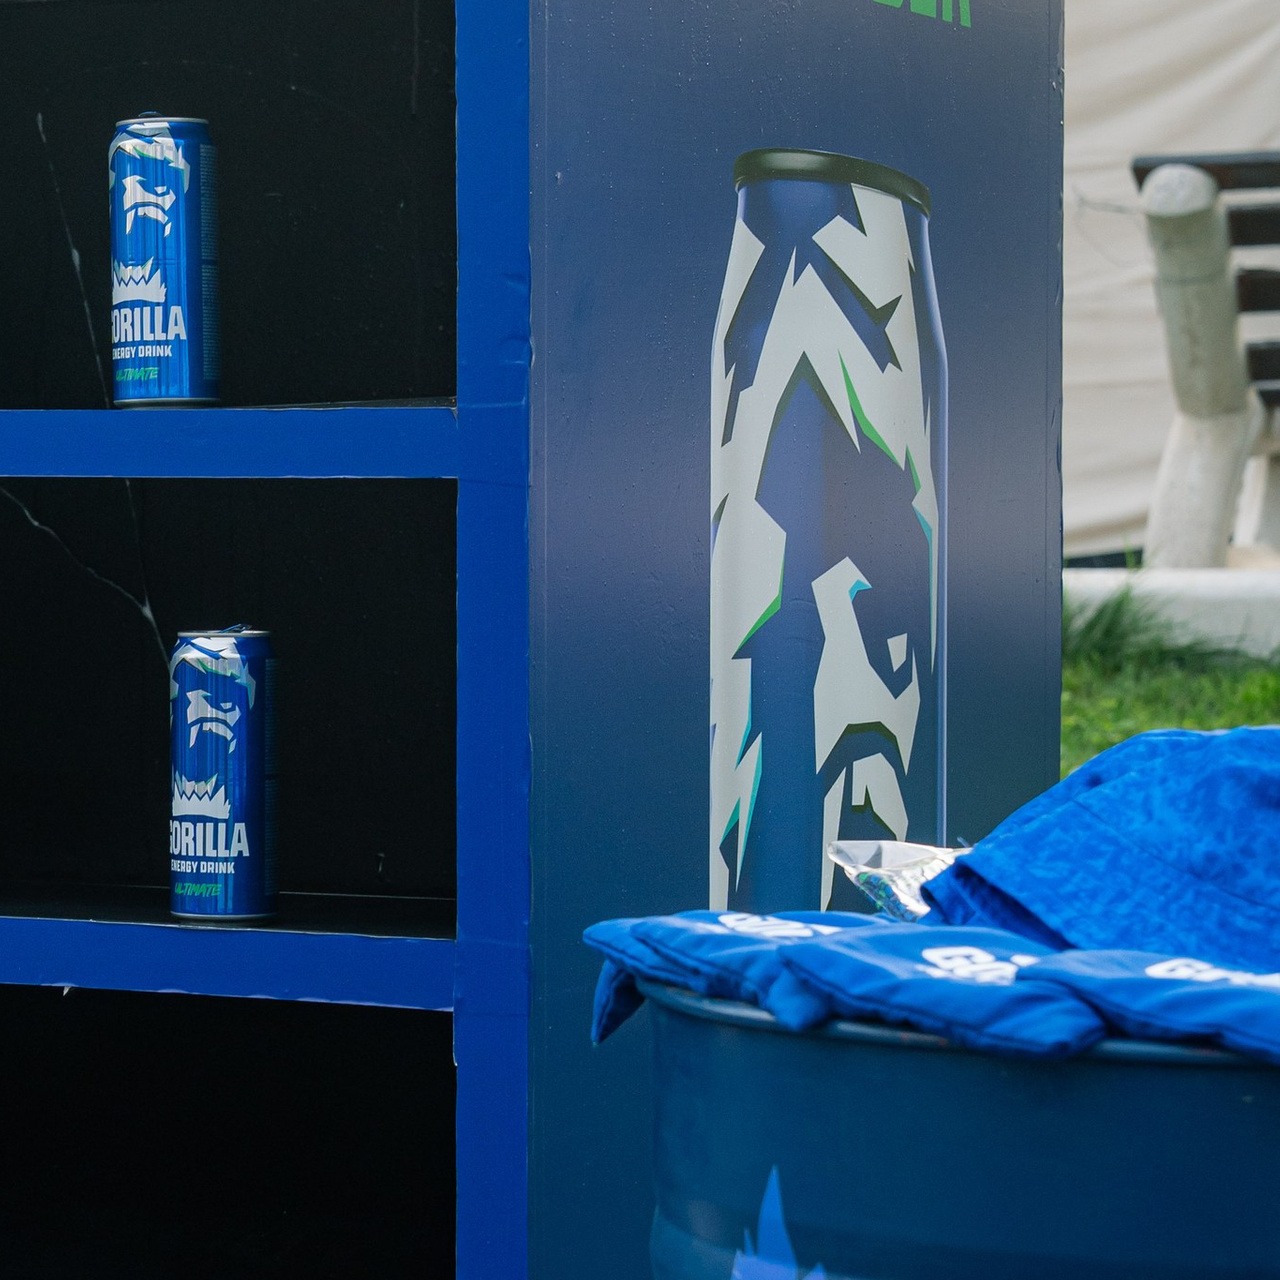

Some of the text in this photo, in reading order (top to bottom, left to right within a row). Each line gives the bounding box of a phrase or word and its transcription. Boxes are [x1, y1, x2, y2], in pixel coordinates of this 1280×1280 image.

[111, 305, 187, 343] ORILLA
[138, 345, 172, 357] DRINK
[200, 861, 235, 874] DRINK
[175, 882, 222, 897] ULTIMATE
